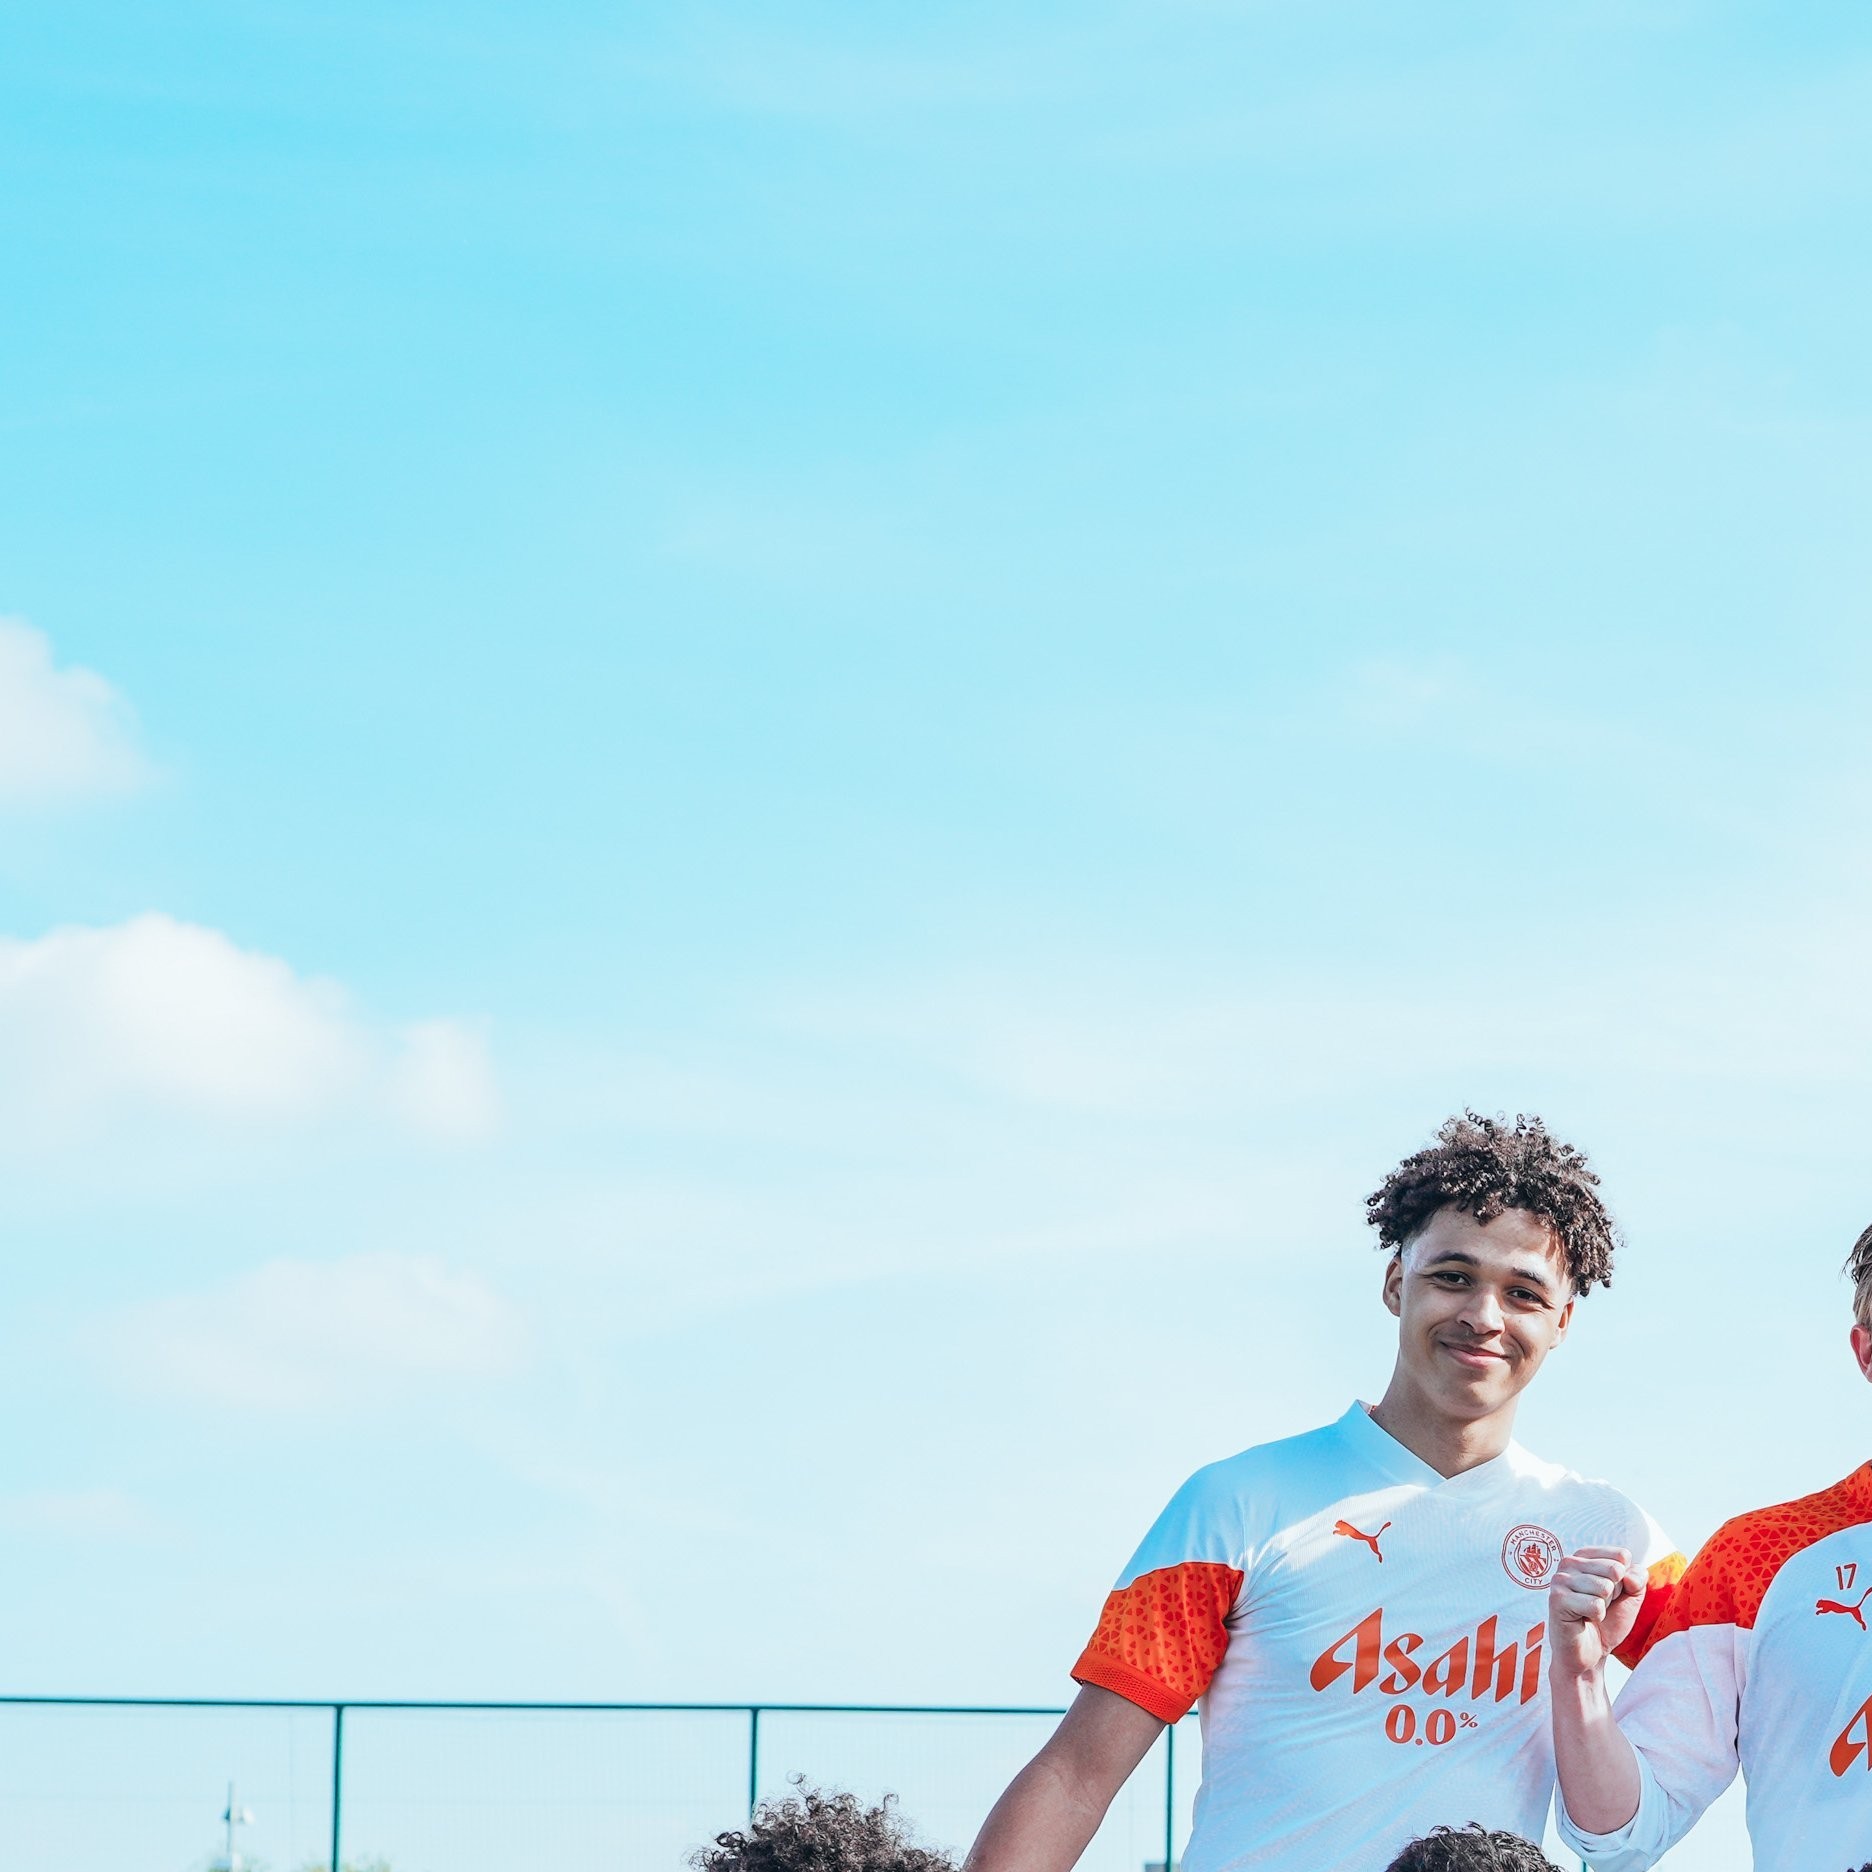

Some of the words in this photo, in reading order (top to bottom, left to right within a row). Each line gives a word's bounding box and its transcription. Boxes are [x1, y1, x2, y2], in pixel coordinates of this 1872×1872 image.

[1510, 1528, 1558, 1553] MANCHESTER
[1524, 1576, 1544, 1586] CITY
[1836, 1563, 1857, 1590] 17
[1310, 1606, 1547, 1706] Asahi
[1385, 1703, 1479, 1746] 0.0%
